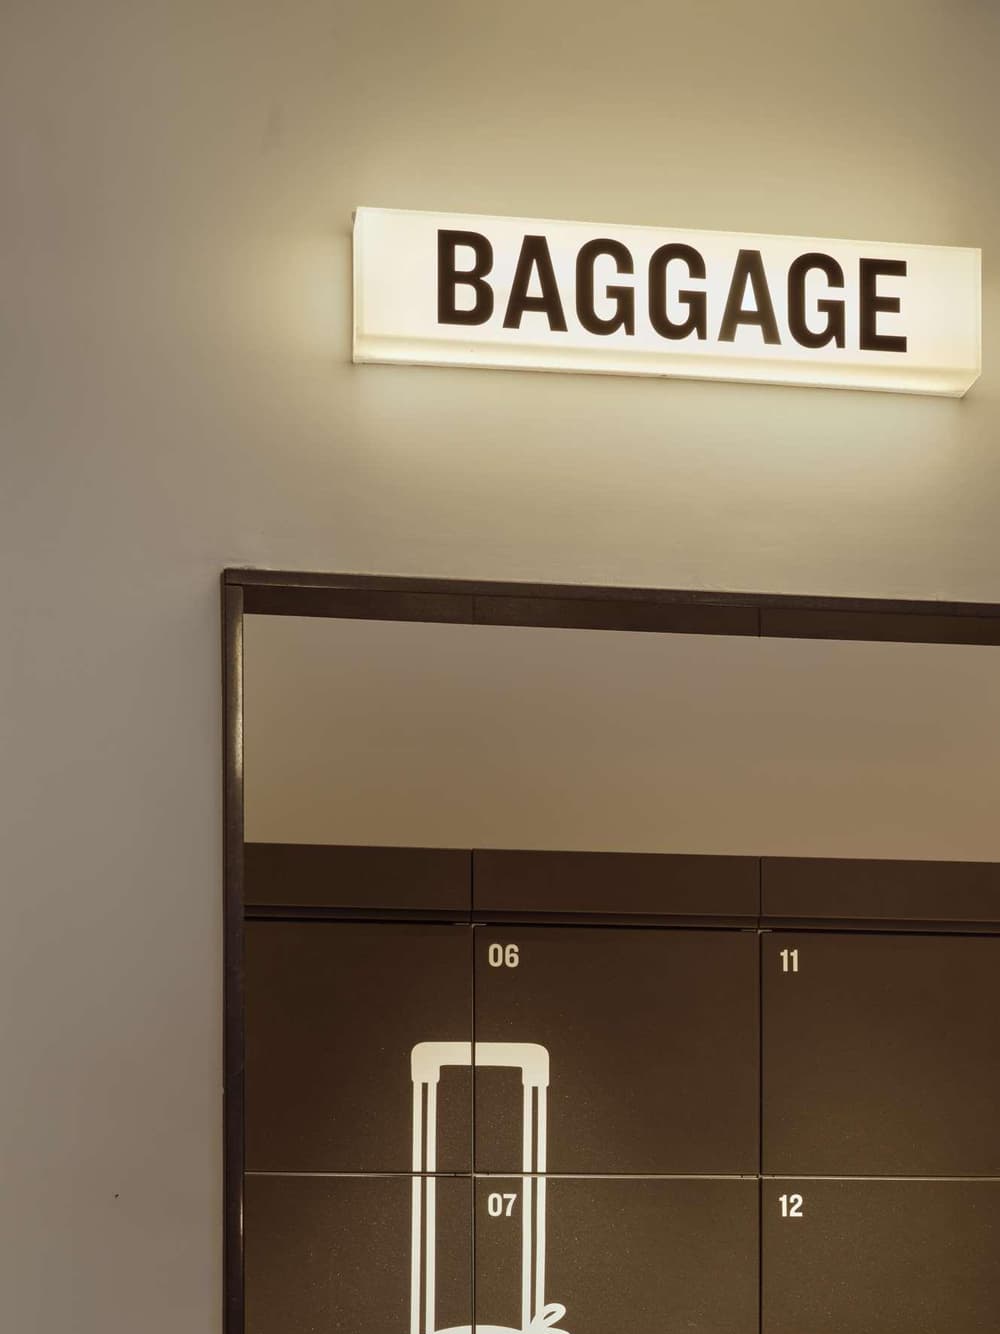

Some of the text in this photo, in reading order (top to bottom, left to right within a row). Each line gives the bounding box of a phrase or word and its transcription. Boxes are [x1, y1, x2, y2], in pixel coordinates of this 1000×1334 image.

[436, 229, 907, 353] BAGGAGE
[488, 943, 520, 968] 06
[779, 948, 799, 973] 11
[487, 1192, 518, 1217] 07
[778, 1193, 804, 1218] 12
